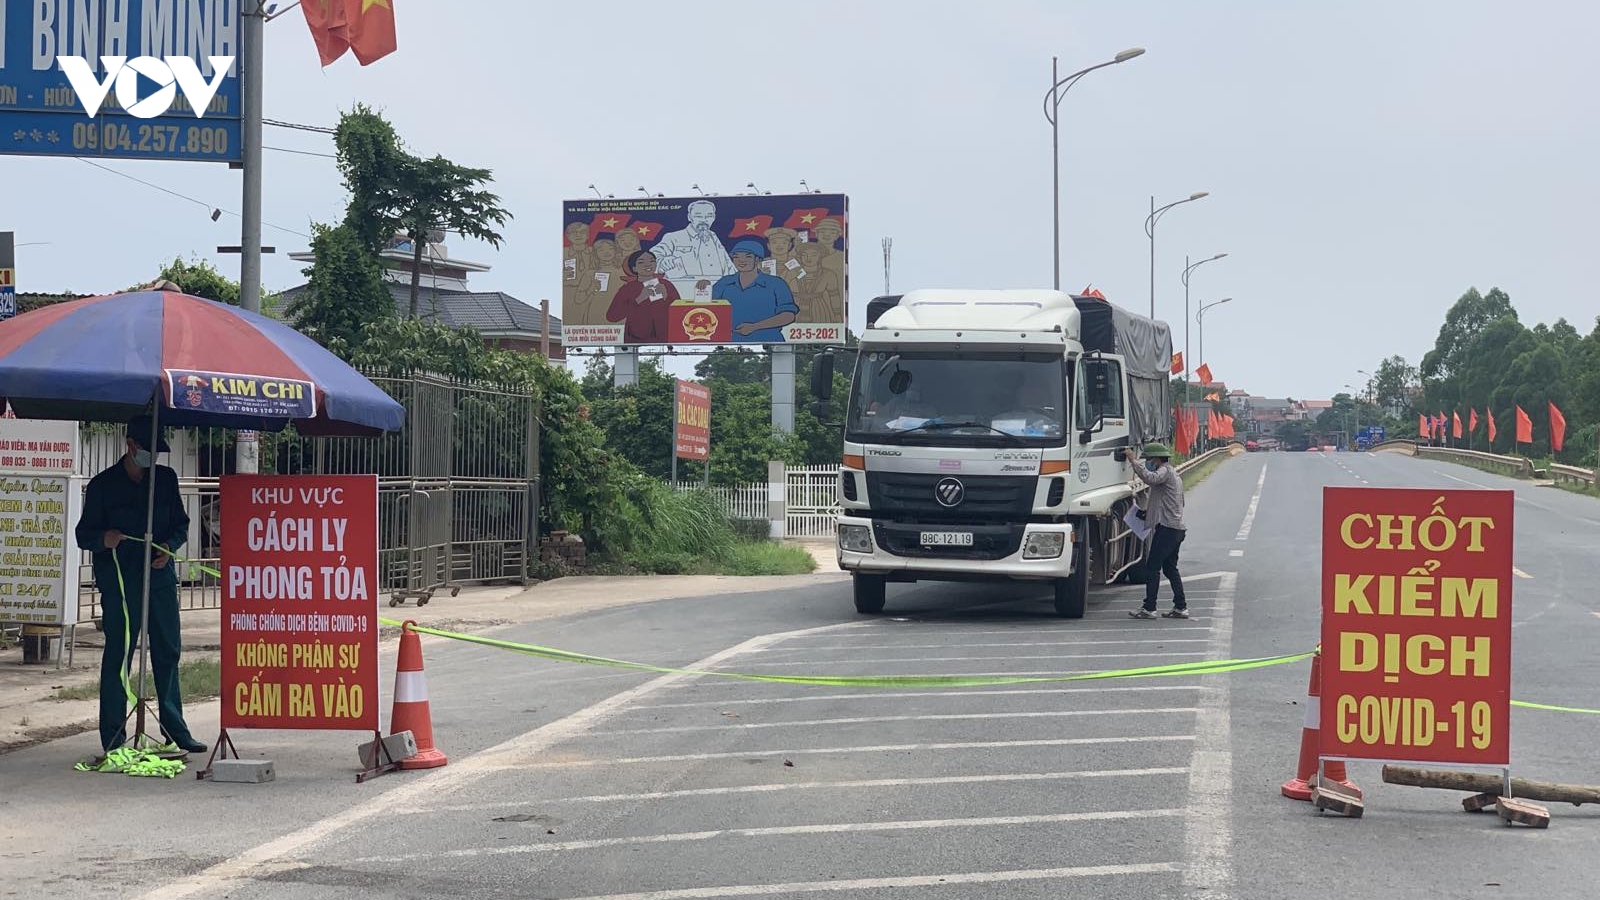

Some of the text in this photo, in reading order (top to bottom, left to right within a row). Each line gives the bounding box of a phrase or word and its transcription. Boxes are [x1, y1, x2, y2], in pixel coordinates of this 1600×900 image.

[73, 122, 228, 154] 0904.257.890
[790, 328, 839, 339] 23-5-2021
[211, 377, 303, 399] KIM CHI
[49, 458, 59, 468] 111
[251, 487, 344, 508] KHU VỰC
[248, 510, 348, 552] CÁCH LY
[1340, 496, 1495, 552] CHỐT
[17, 584, 52, 597] 24/7
[229, 555, 368, 600] PHONG TỎA
[1334, 559, 1499, 618] KIỂM
[231, 608, 367, 636] PHÒNG CHỐNG DỊCH BỆNH COVID-19
[236, 638, 361, 674] KHÔNG PHẬN SỰ
[1339, 631, 1491, 682] DỊCH
[235, 670, 363, 719] CẤM RA VÀO
[1336, 694, 1492, 750] COVID-19
